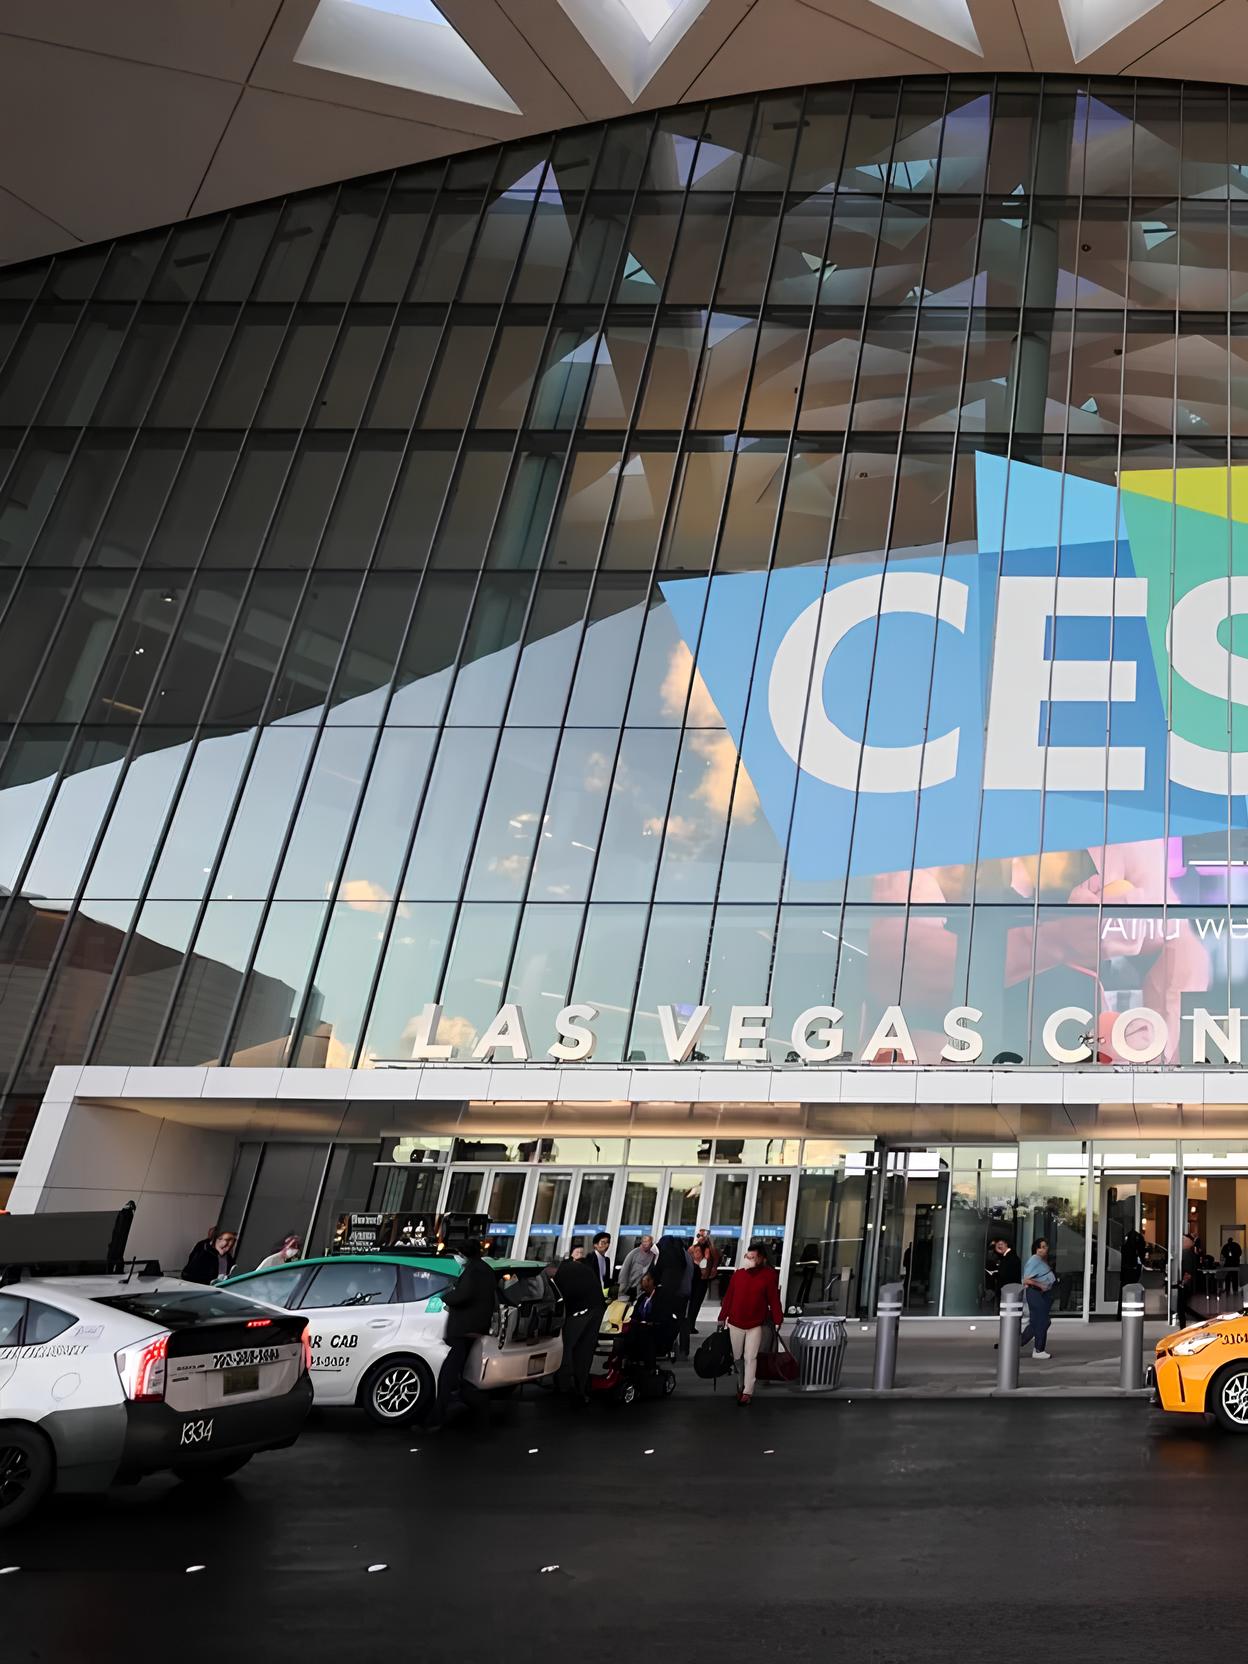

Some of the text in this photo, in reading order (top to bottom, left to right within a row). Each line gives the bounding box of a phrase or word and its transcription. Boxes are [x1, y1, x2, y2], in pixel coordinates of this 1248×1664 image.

[411, 1003, 599, 1063] LAS
[657, 1005, 987, 1064] VEGAS
[330, 1334, 358, 1349] CAB
